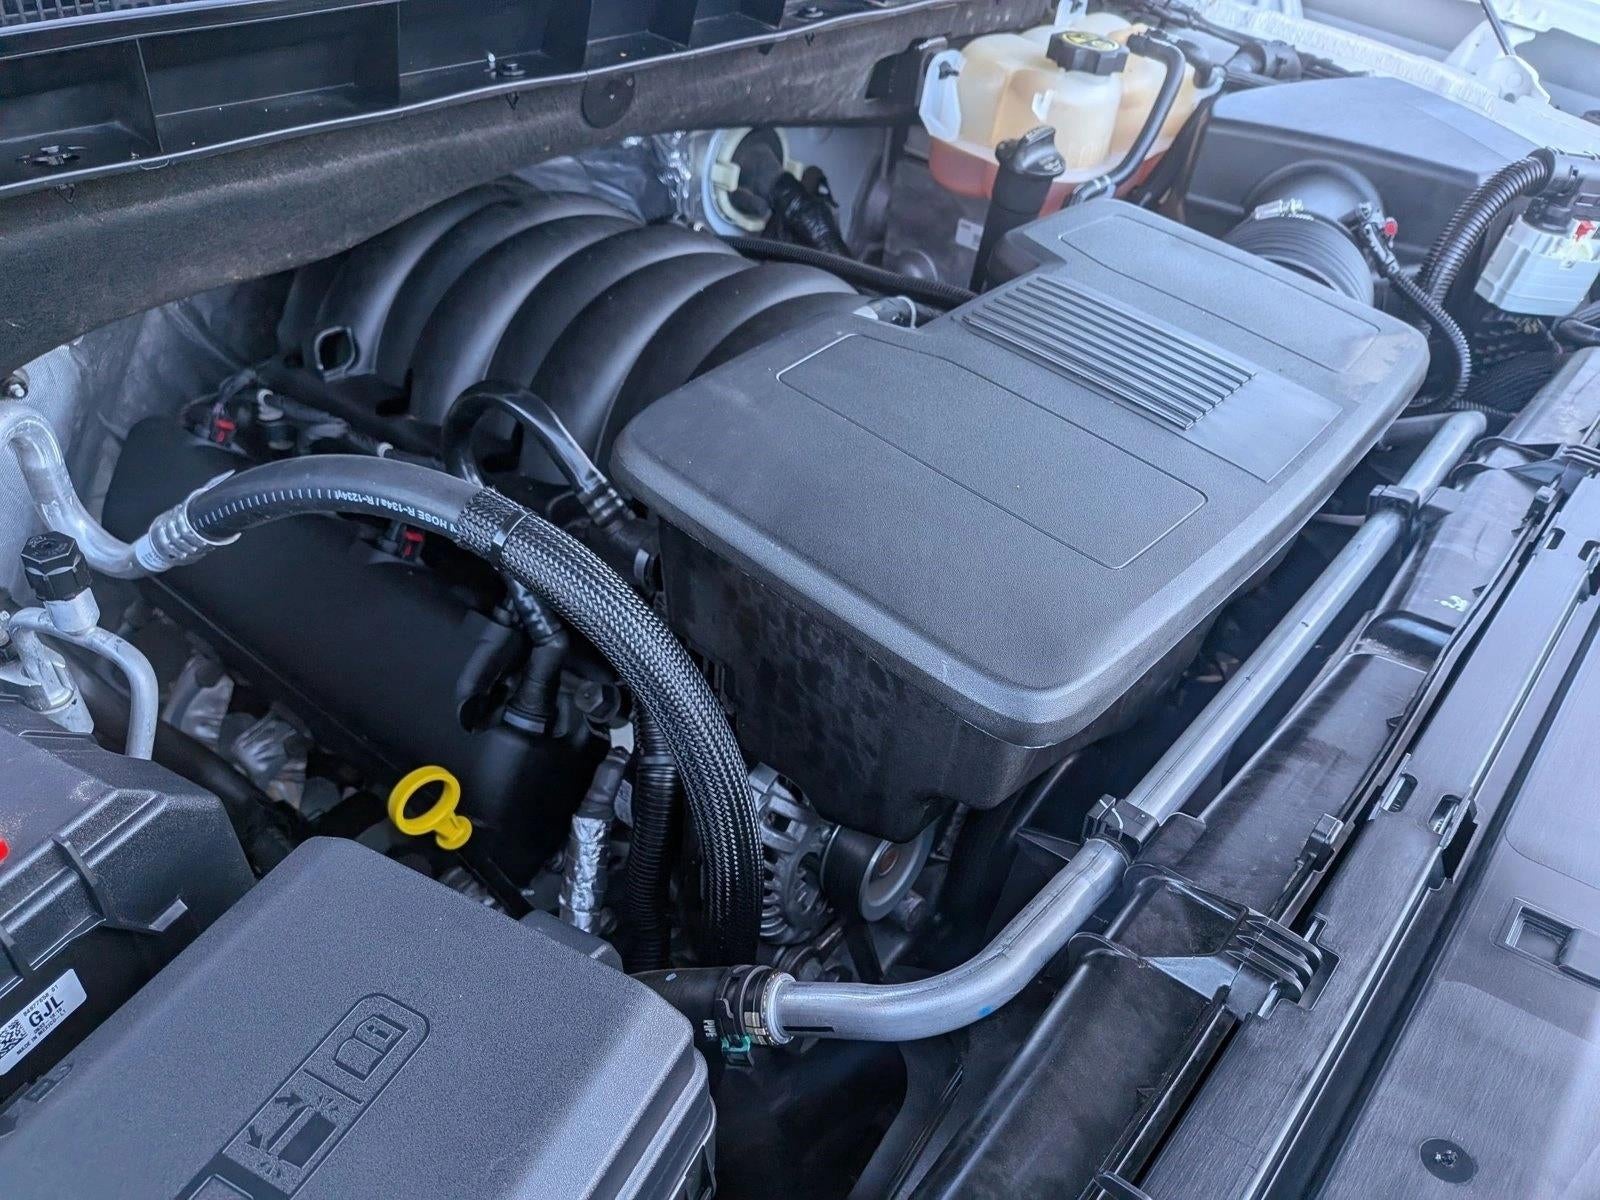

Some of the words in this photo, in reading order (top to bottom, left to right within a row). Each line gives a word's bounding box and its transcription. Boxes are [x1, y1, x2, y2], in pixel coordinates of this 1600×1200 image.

[381, 498, 415, 517] R-134a
[417, 510, 448, 530] HOSE
[29, 996, 64, 1027] GJL
[17, 1041, 31, 1055] MADE
